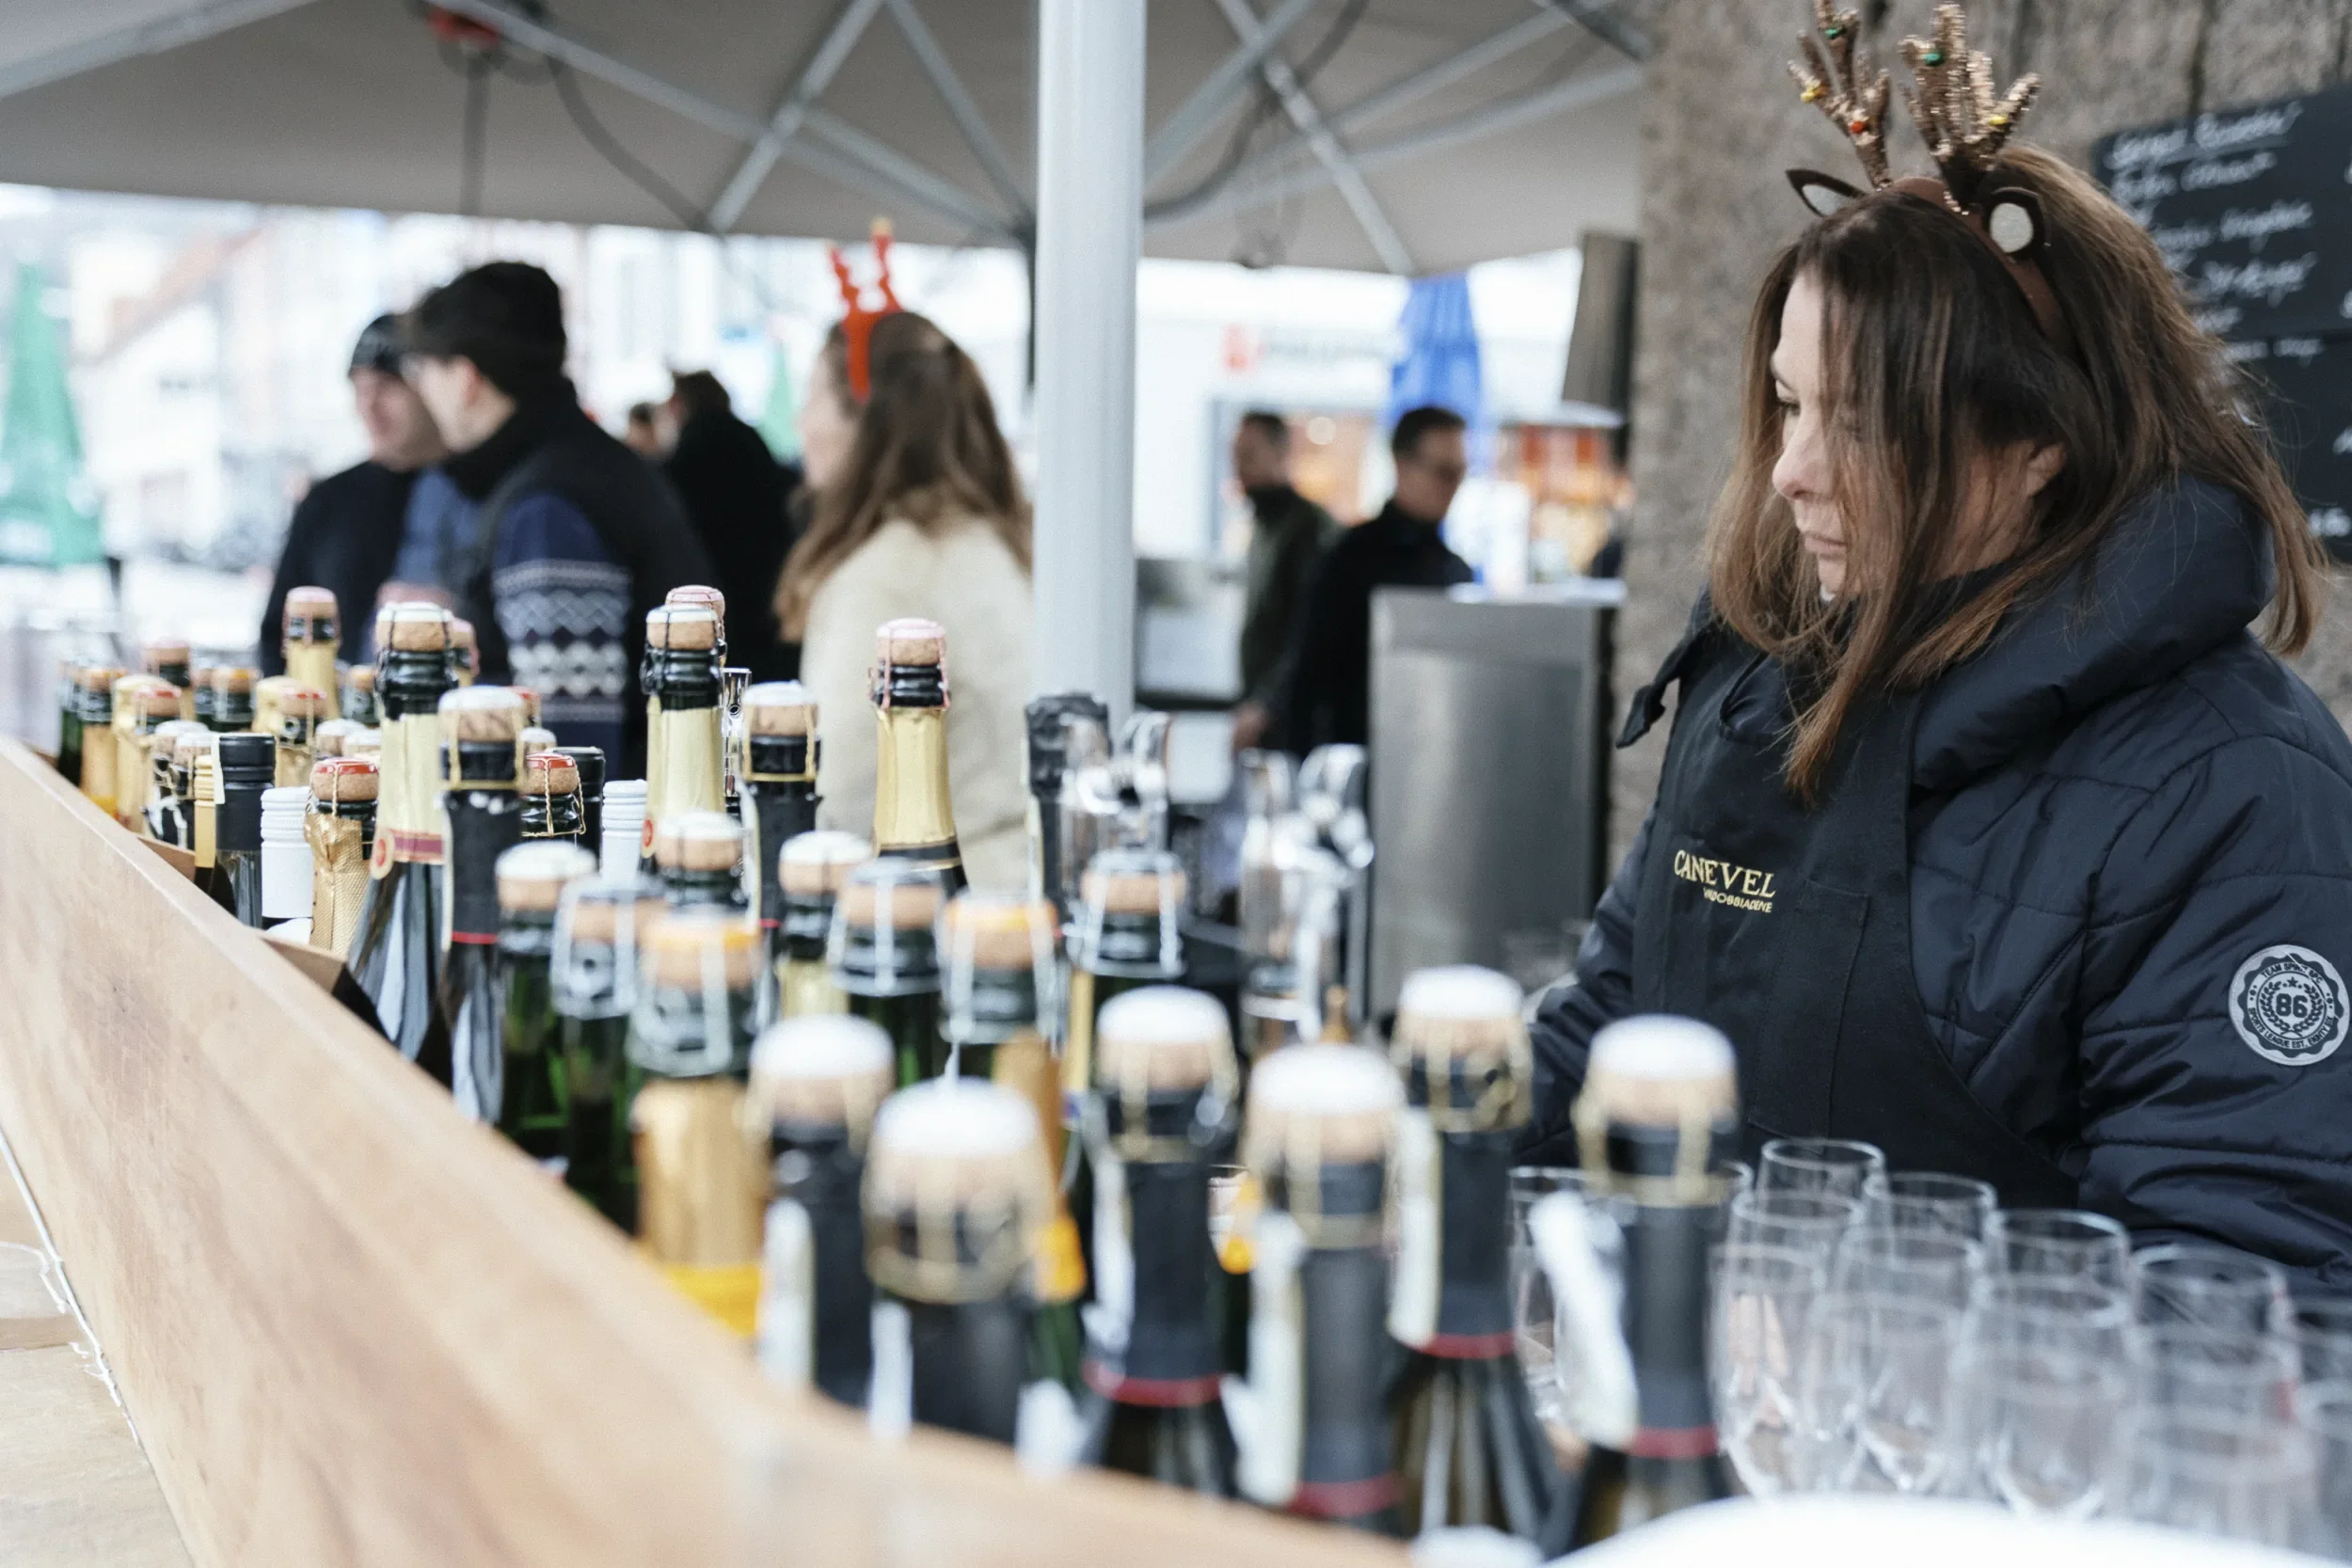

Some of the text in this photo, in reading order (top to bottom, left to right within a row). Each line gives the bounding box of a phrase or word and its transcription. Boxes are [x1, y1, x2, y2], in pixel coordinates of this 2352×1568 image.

[1674, 849, 1776, 898] CANEVEL
[2261, 964, 2282, 978] TEAM
[2276, 993, 2308, 1018] 86
[2265, 1031, 2290, 1048] LEAGUE
